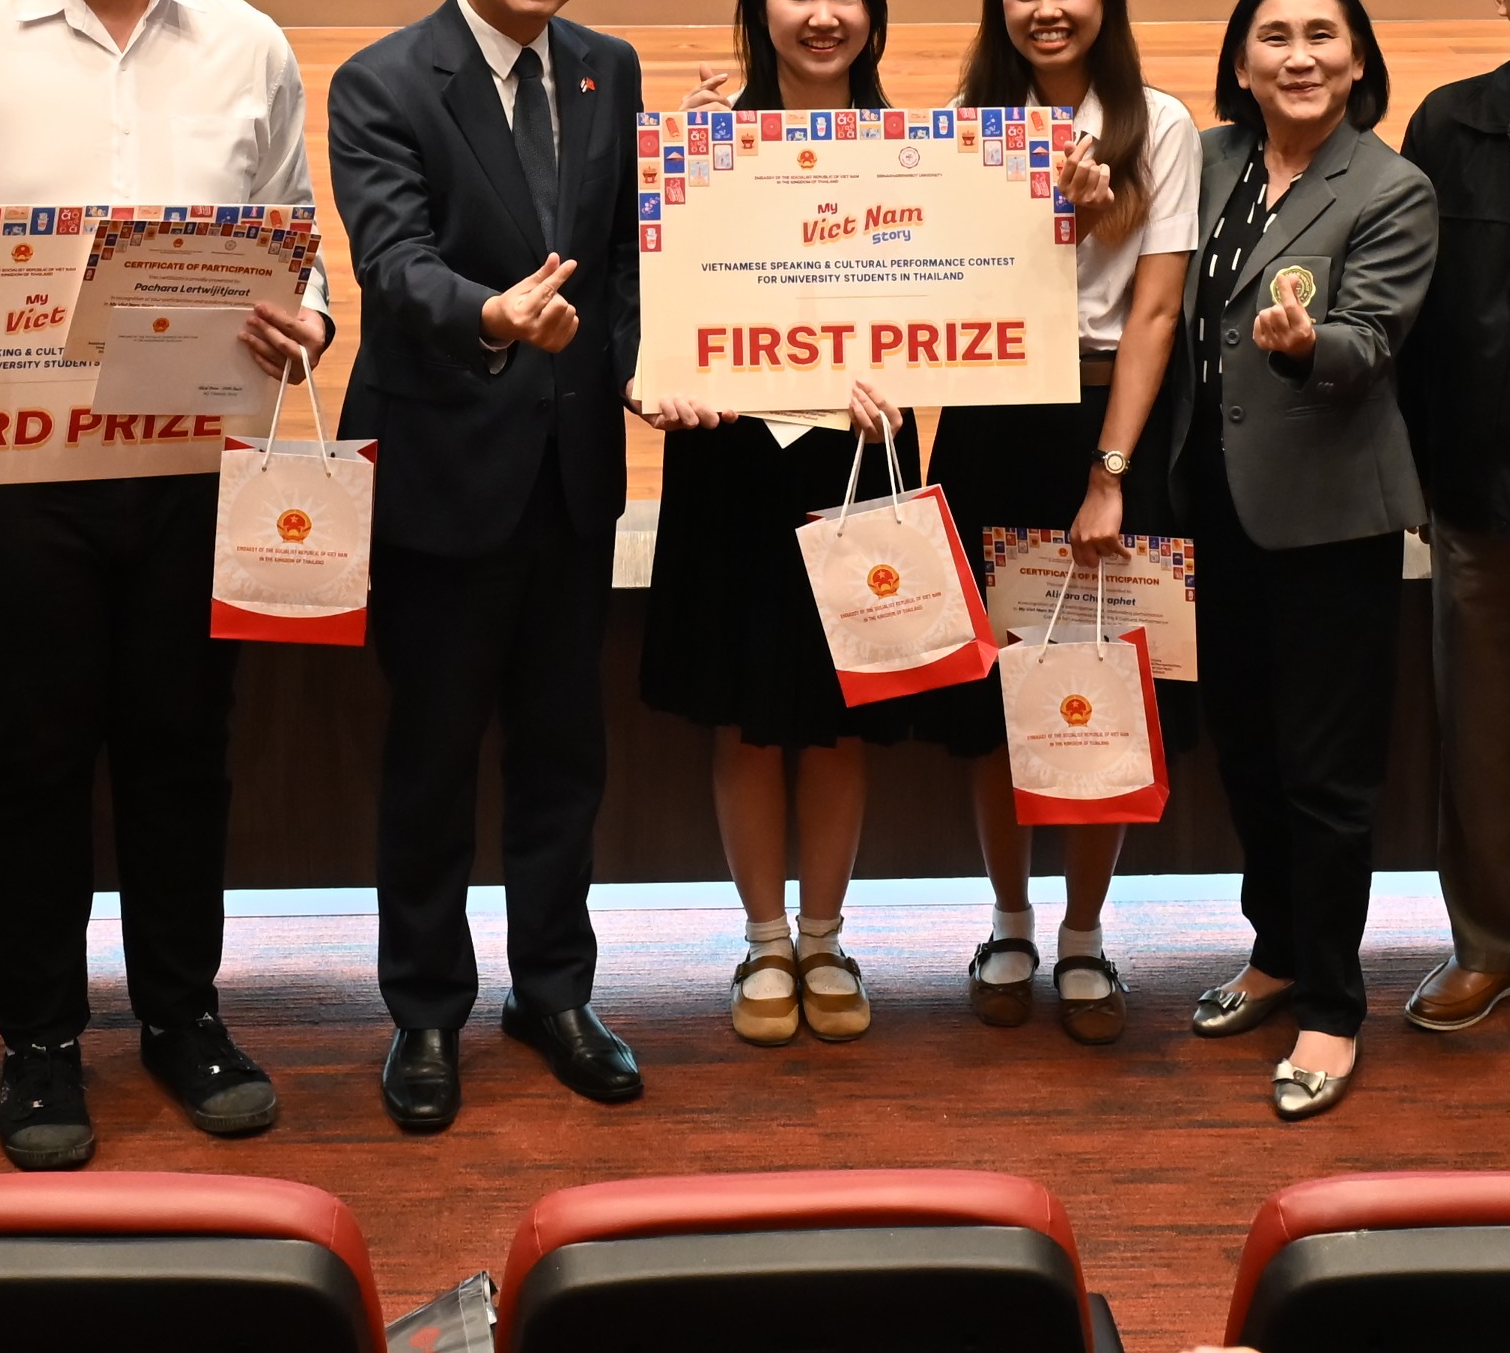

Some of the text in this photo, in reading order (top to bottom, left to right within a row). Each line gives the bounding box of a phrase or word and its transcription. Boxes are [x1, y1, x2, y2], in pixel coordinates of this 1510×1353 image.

[817, 202, 838, 215] My
[802, 205, 924, 244] Viet Nam
[123, 260, 272, 276] CERTIFICATE OF PARTICIPATION
[701, 257, 1015, 271] VIETNAMESE SPEAKING & CULTURAL PERFORMANCE CONTEST
[757, 271, 964, 284] FOR UNIVERSITY STUDENTS IN THAILAND
[134, 282, 178, 292] Pachara
[26, 292, 49, 308] My
[697, 321, 1026, 367] FIRST PRIZE
[24, 348, 31, 356] &
[35, 347, 63, 358] CULT
[67, 409, 222, 443] PRIZE
